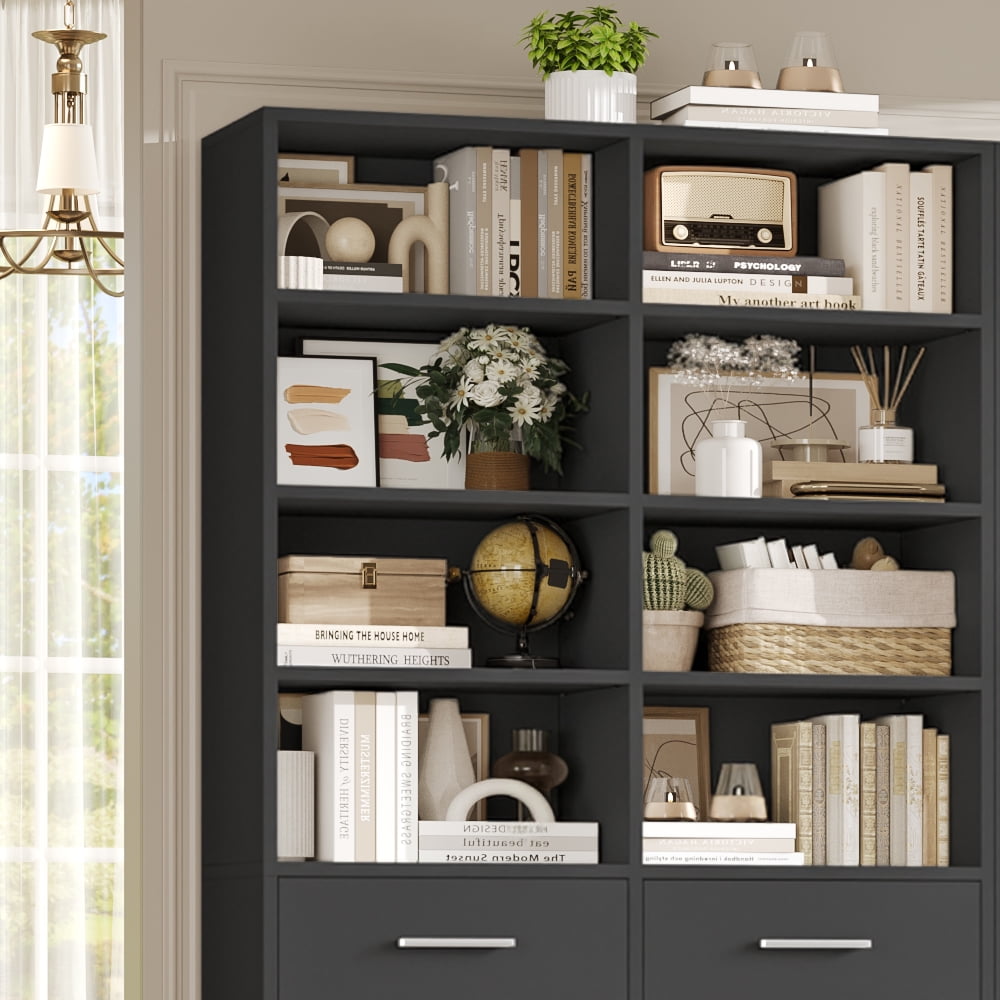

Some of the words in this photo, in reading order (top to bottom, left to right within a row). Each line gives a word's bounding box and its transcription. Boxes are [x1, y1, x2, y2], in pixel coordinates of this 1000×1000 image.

[918, 229, 926, 249] TARTE
[734, 261, 802, 272] PSYCHOLOGY
[918, 250, 926, 269] TATIN
[917, 271, 927, 301] GÂTEAUX
[744, 295, 797, 309] another
[801, 298, 820, 310] art
[824, 297, 857, 312] book
[315, 629, 354, 641] BRINGING
[356, 631, 372, 641] THE
[374, 631, 400, 641] HOUSE
[402, 632, 425, 642] HOME
[331, 653, 398, 666] WUTHERING
[404, 655, 450, 667] HEIGHTS
